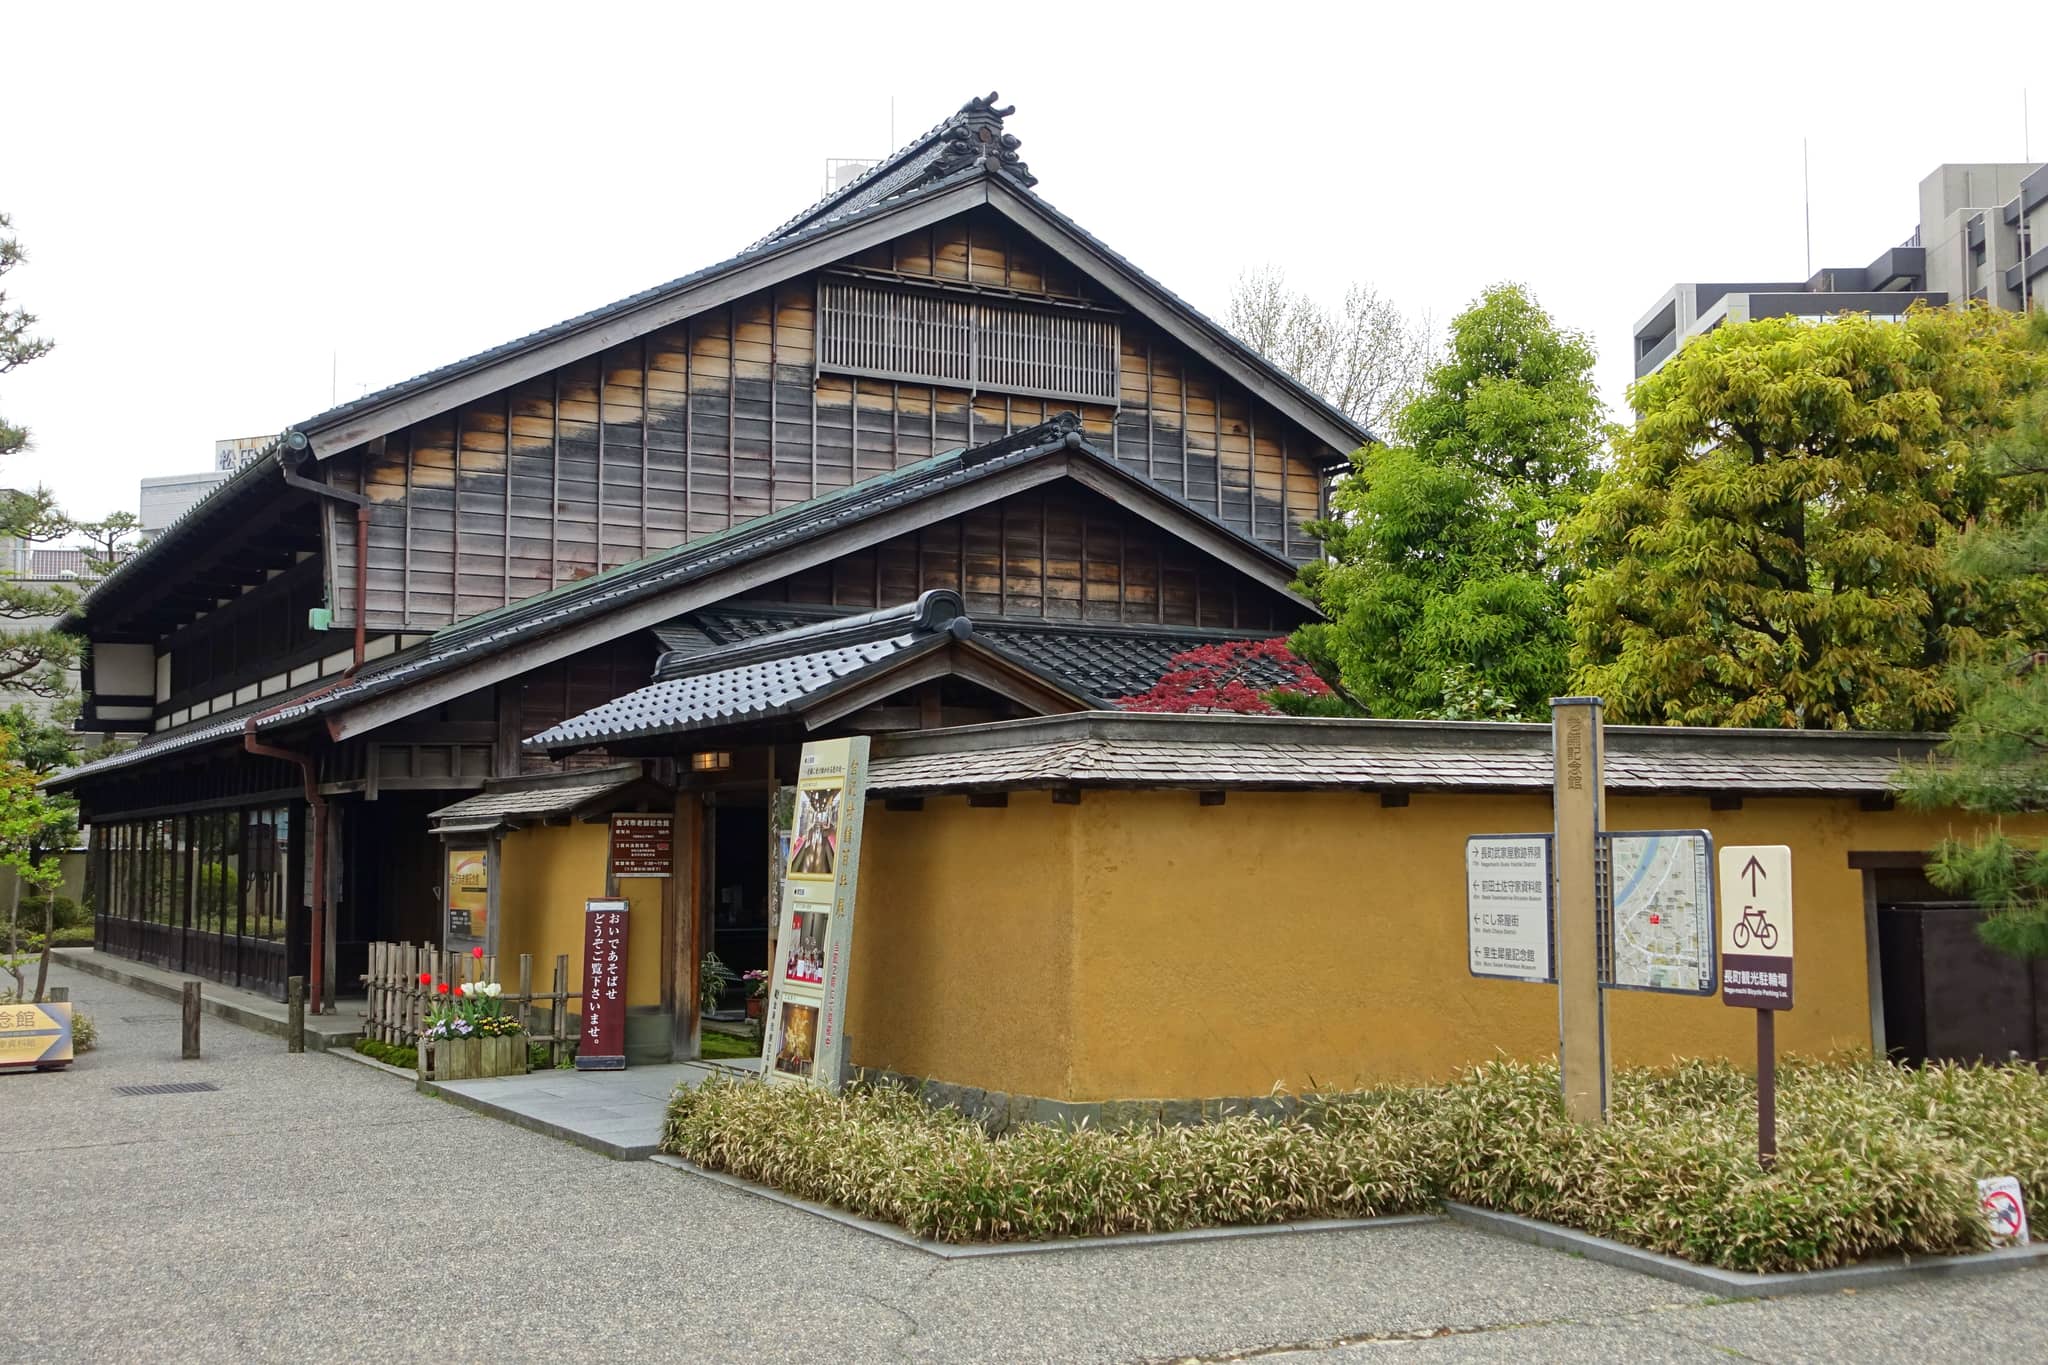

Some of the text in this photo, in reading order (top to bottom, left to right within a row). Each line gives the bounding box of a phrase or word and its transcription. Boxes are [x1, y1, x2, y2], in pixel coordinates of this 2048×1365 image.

[1481, 846, 1541, 859] 長町武家屋敷跡界隈
[1481, 880, 1542, 893] 前田土佐守家資料館
[1482, 913, 1519, 927] にし茶屋街
[605, 913, 620, 1000] おいであそばせ
[1483, 946, 1535, 962] 室生犀星記念館
[587, 912, 605, 1045] どうぞご覧下さいませ。
[1724, 969, 1788, 987] 長町観光駐輪場
